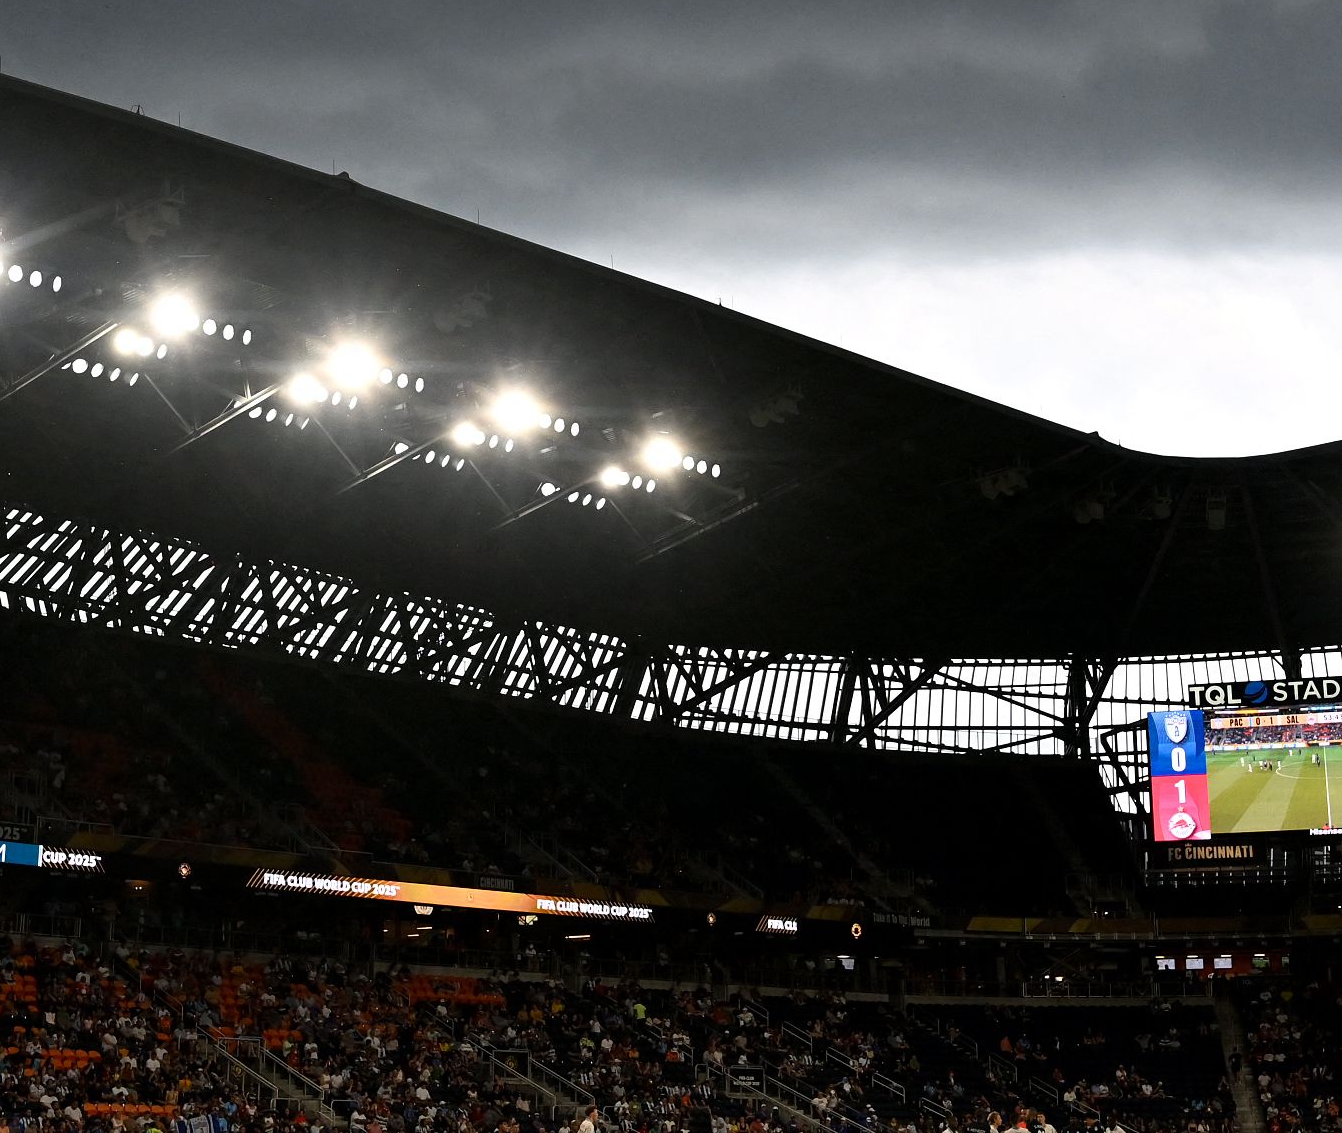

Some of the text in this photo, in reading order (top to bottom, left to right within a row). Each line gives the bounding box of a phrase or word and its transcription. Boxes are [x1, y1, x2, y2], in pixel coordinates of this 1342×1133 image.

[1189, 684, 1241, 706] TQL
[1230, 719, 1243, 727] PAC
[1171, 747, 1187, 772] 0
[1175, 780, 1186, 804] 1
[1309, 828, 1342, 836] Hisense
[43, 851, 67, 864] CUP
[1168, 846, 1254, 861] FC CINCINNATI
[263, 873, 286, 886] FIFA
[287, 876, 313, 889] CLUB
[314, 877, 350, 892] WORLD
[351, 882, 371, 894] CUP
[537, 899, 555, 910] FIFA
[556, 901, 579, 913] CLUB
[579, 902, 610, 915] WORLD
[610, 905, 628, 917] CUP
